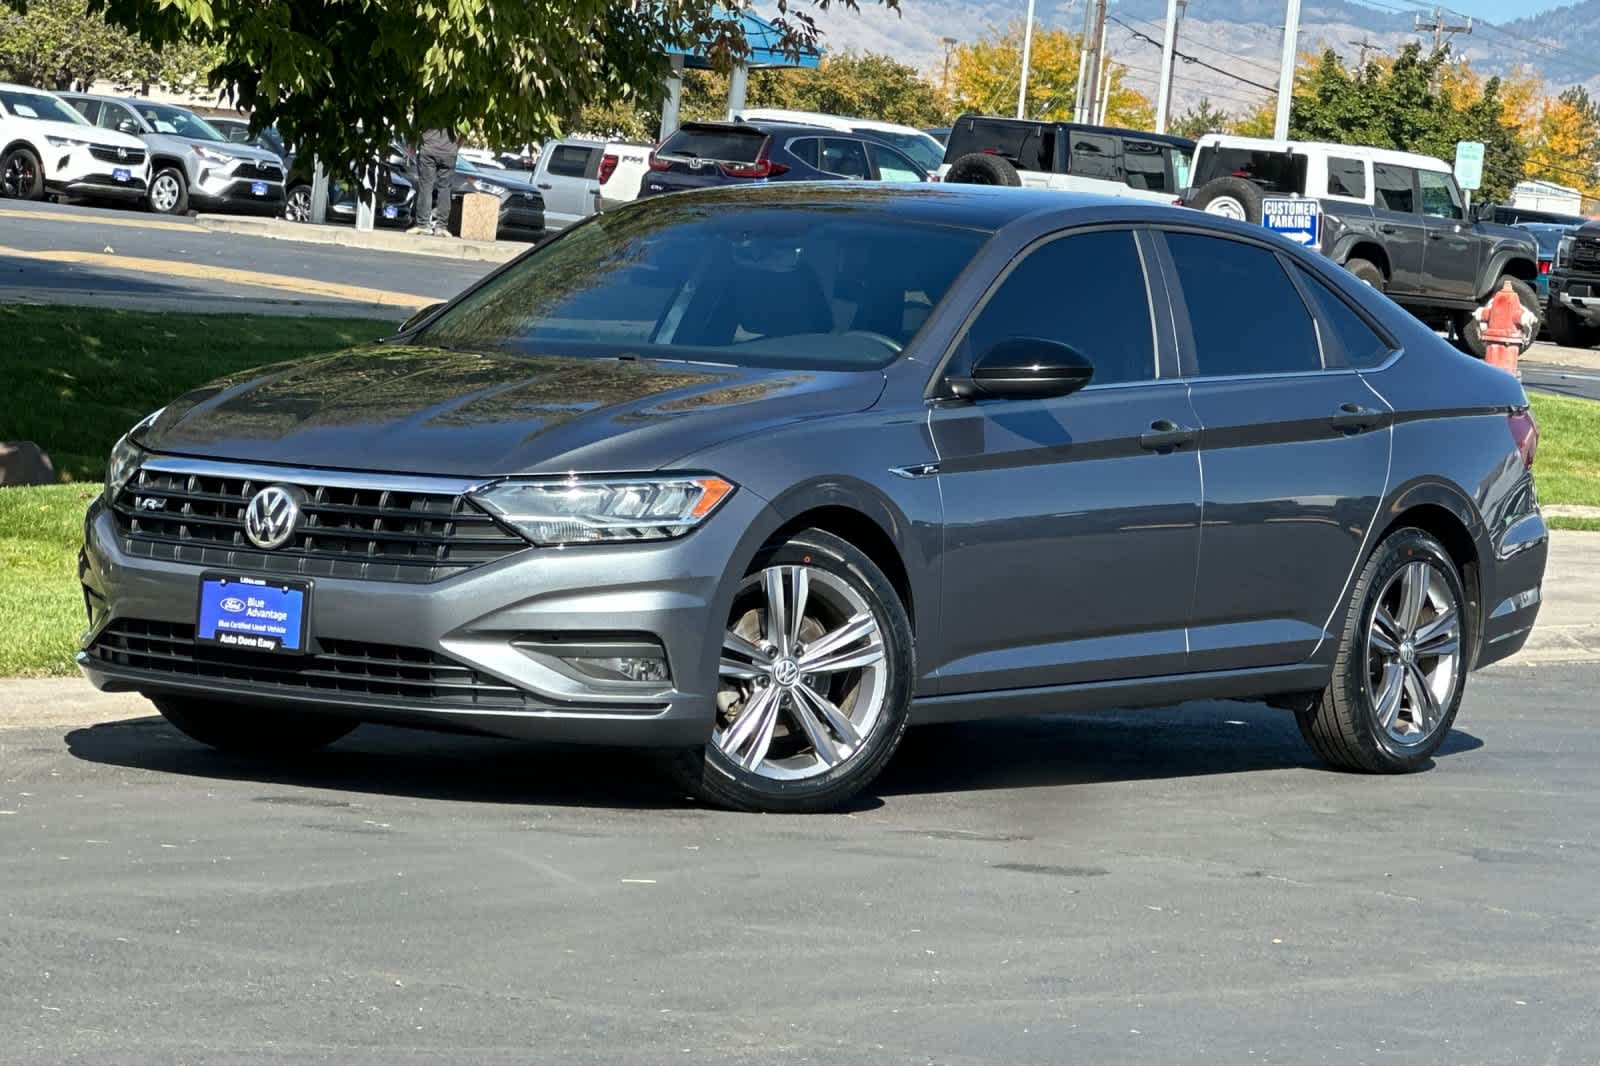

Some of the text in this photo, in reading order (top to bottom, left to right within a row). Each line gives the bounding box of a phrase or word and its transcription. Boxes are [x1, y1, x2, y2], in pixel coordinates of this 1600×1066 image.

[1265, 202, 1316, 215] CUSTOMER
[1269, 215, 1311, 228] PARKING
[247, 597, 265, 608] Blue
[246, 607, 287, 622] Advantage
[220, 633, 275, 651] Auto Done Easy
